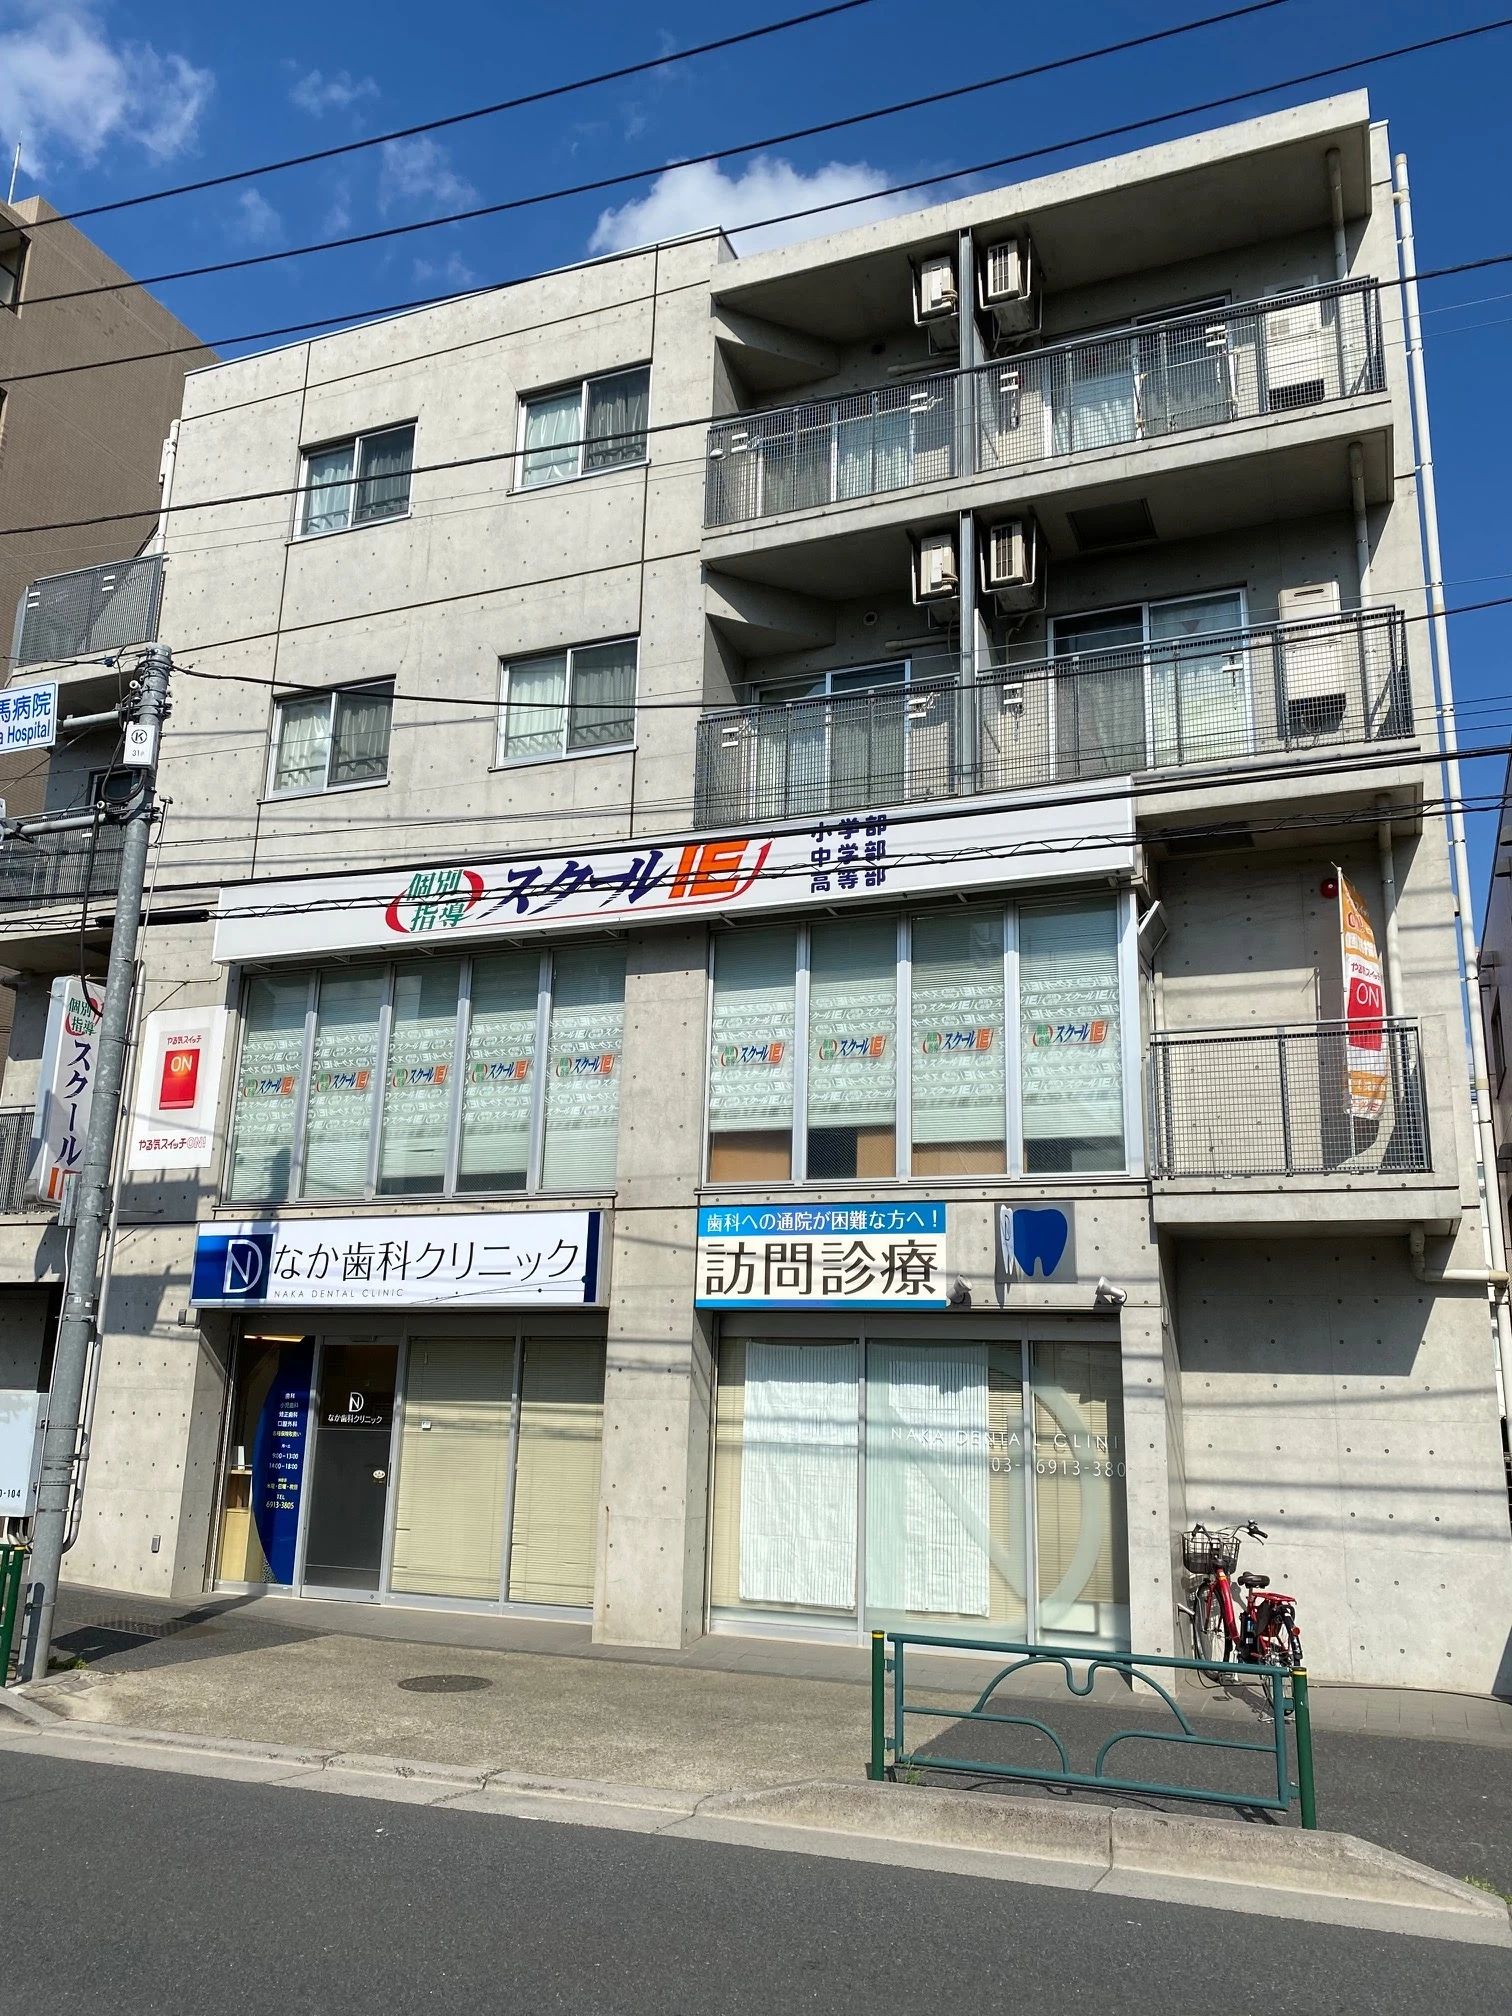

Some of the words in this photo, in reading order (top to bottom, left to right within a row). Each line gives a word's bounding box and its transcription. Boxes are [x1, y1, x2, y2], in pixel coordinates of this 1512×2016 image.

[8, 719, 50, 744] Hospital
[811, 814, 887, 842] 小学部
[811, 840, 886, 867] 中学部
[408, 869, 464, 901] 個別
[811, 868, 886, 893] 高等部
[410, 902, 466, 931] 指導
[1356, 982, 1380, 1009] ON
[167, 1035, 202, 1045] やる気スイッチ
[170, 1055, 193, 1072] ON
[274, 1238, 579, 1282] なか歯科クリニック
[705, 1239, 938, 1296] 訪問診療
[274, 1290, 304, 1298] NAKA
[312, 1290, 355, 1298] DENTAL
[362, 1288, 404, 1298] CLINIC
[328, 1413, 382, 1424] なか歯科クリニック
